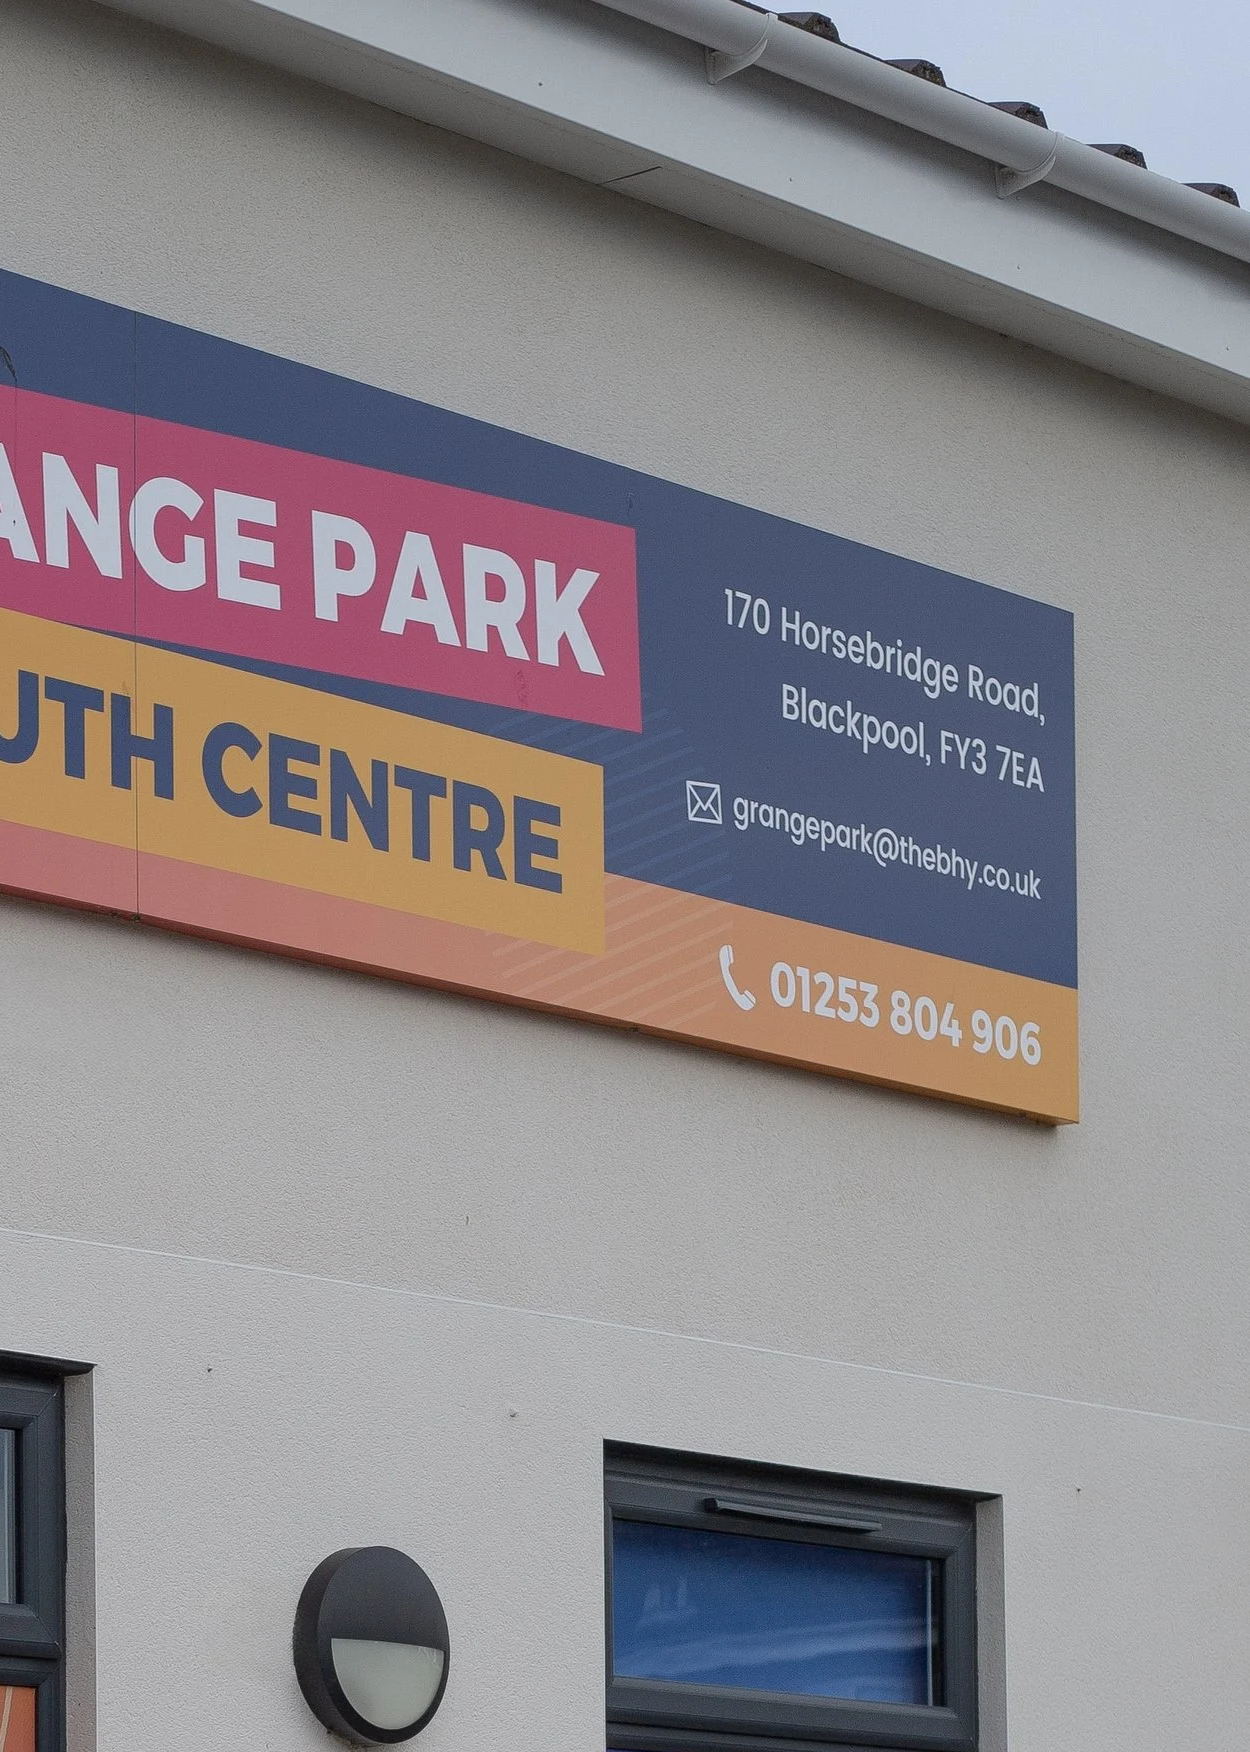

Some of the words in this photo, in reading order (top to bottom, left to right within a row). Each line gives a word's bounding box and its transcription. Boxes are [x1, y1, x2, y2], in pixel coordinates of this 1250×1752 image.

[311, 510, 606, 677] PARK
[724, 589, 771, 636] 170
[781, 606, 960, 699] Horsebridge
[967, 663, 1047, 726] Road,
[781, 683, 932, 767] Blackpool,
[940, 730, 988, 776] FY3
[995, 745, 1046, 794] 7EA
[201, 721, 564, 895] CENTRE
[732, 794, 1042, 900] grangepark@thebhy.co.uk
[769, 961, 880, 1028] 01253
[889, 990, 963, 1048] 804
[971, 1009, 1042, 1066] 906
